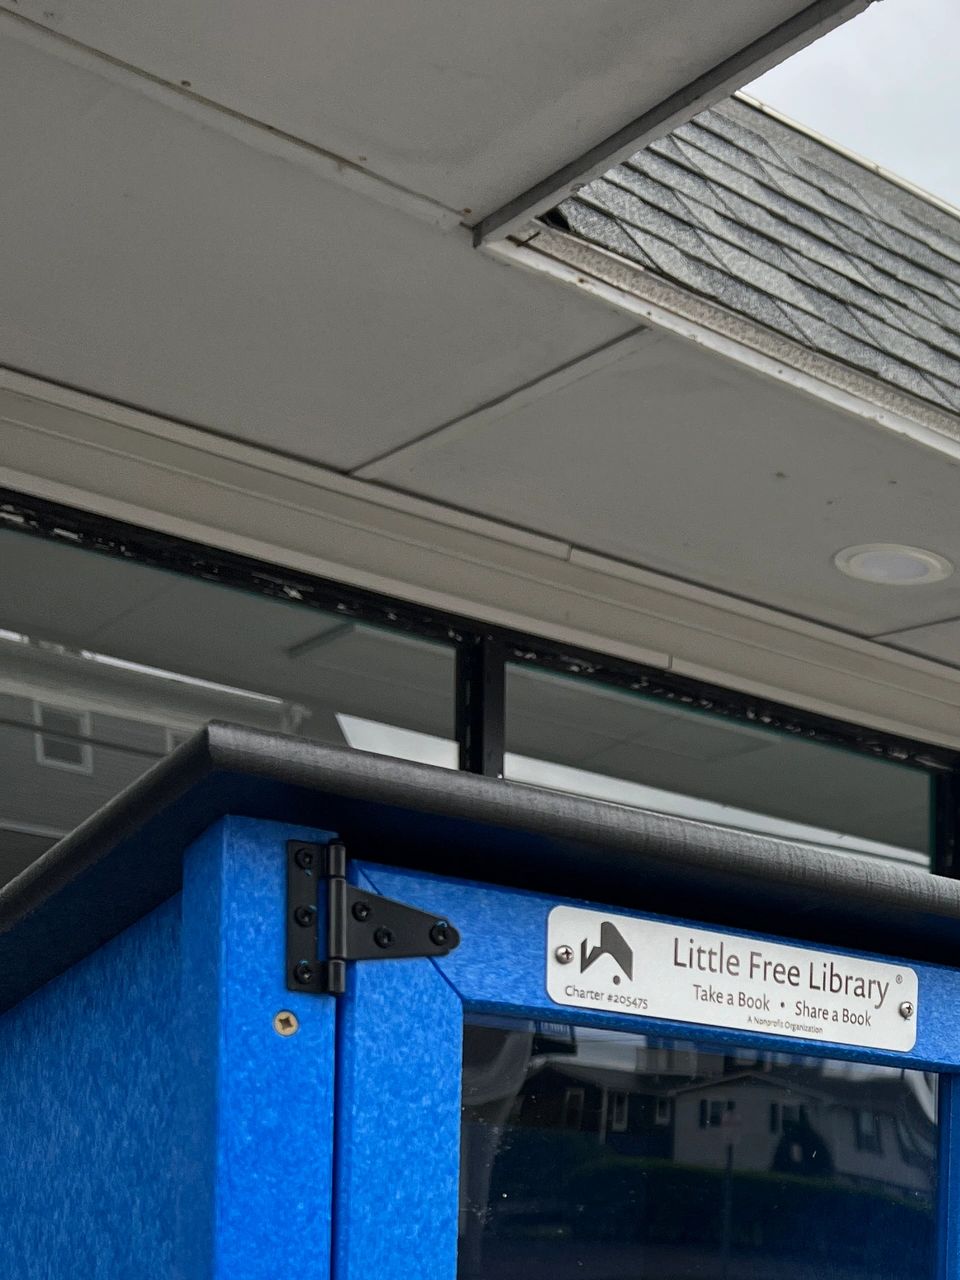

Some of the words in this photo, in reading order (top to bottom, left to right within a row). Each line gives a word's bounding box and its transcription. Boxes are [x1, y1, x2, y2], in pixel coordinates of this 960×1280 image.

[673, 937, 741, 976] Little
[748, 951, 800, 987] Free
[809, 961, 889, 1010] Library
[565, 985, 606, 1002] Charter
[608, 991, 648, 1010] #205475
[693, 984, 724, 1003] Take
[726, 993, 735, 1006] a
[738, 991, 770, 1012] Book
[747, 1016, 753, 1024] A
[784, 1021, 824, 1034] Organization
[795, 1001, 830, 1020] Share
[832, 1010, 839, 1023] a
[842, 1008, 872, 1027] Book
